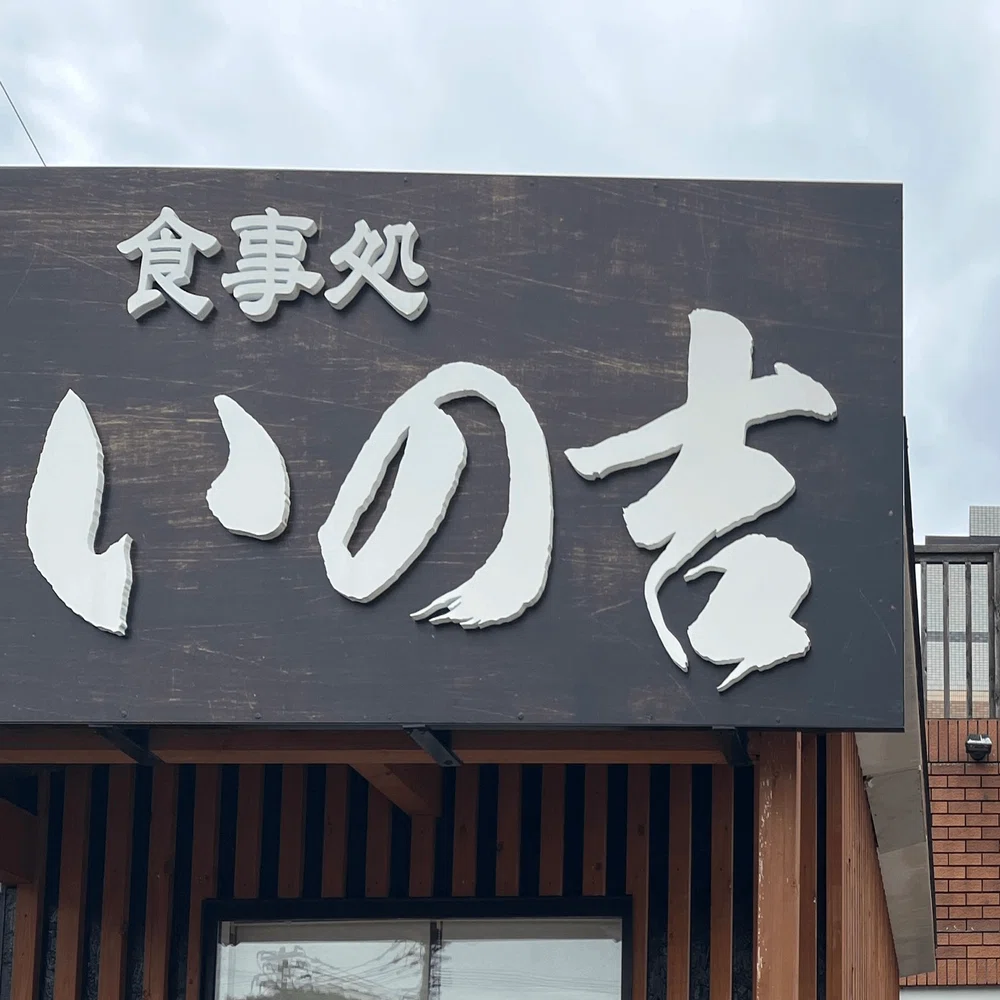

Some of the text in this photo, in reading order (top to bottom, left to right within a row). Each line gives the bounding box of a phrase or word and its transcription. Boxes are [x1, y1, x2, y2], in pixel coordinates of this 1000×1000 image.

[117, 206, 429, 321] 食事処
[26, 309, 837, 693] いの吉
